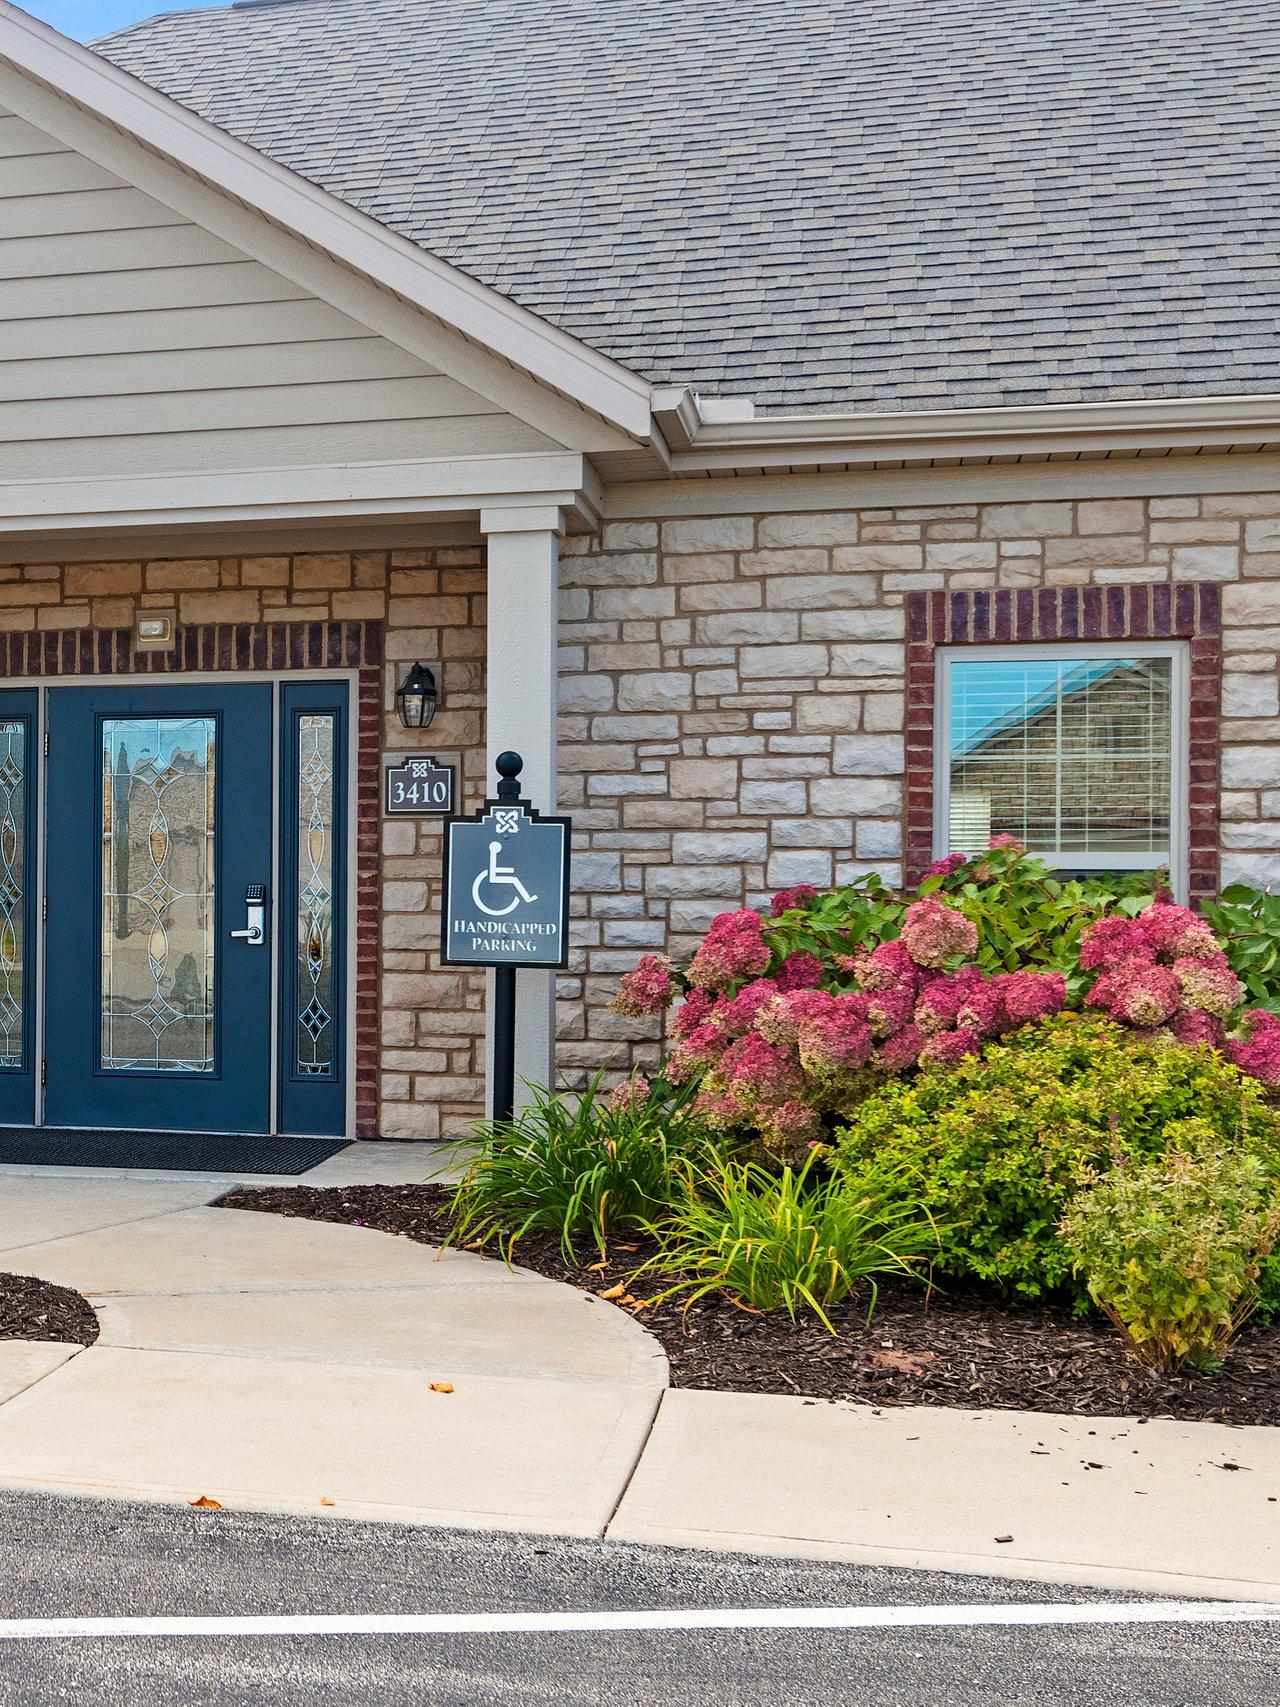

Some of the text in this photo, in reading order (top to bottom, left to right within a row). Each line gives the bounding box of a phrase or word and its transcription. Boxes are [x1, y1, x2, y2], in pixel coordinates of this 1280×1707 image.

[392, 782, 447, 804] 3410
[454, 920, 557, 935] HANDICAPPED
[472, 938, 537, 952] PARKING
